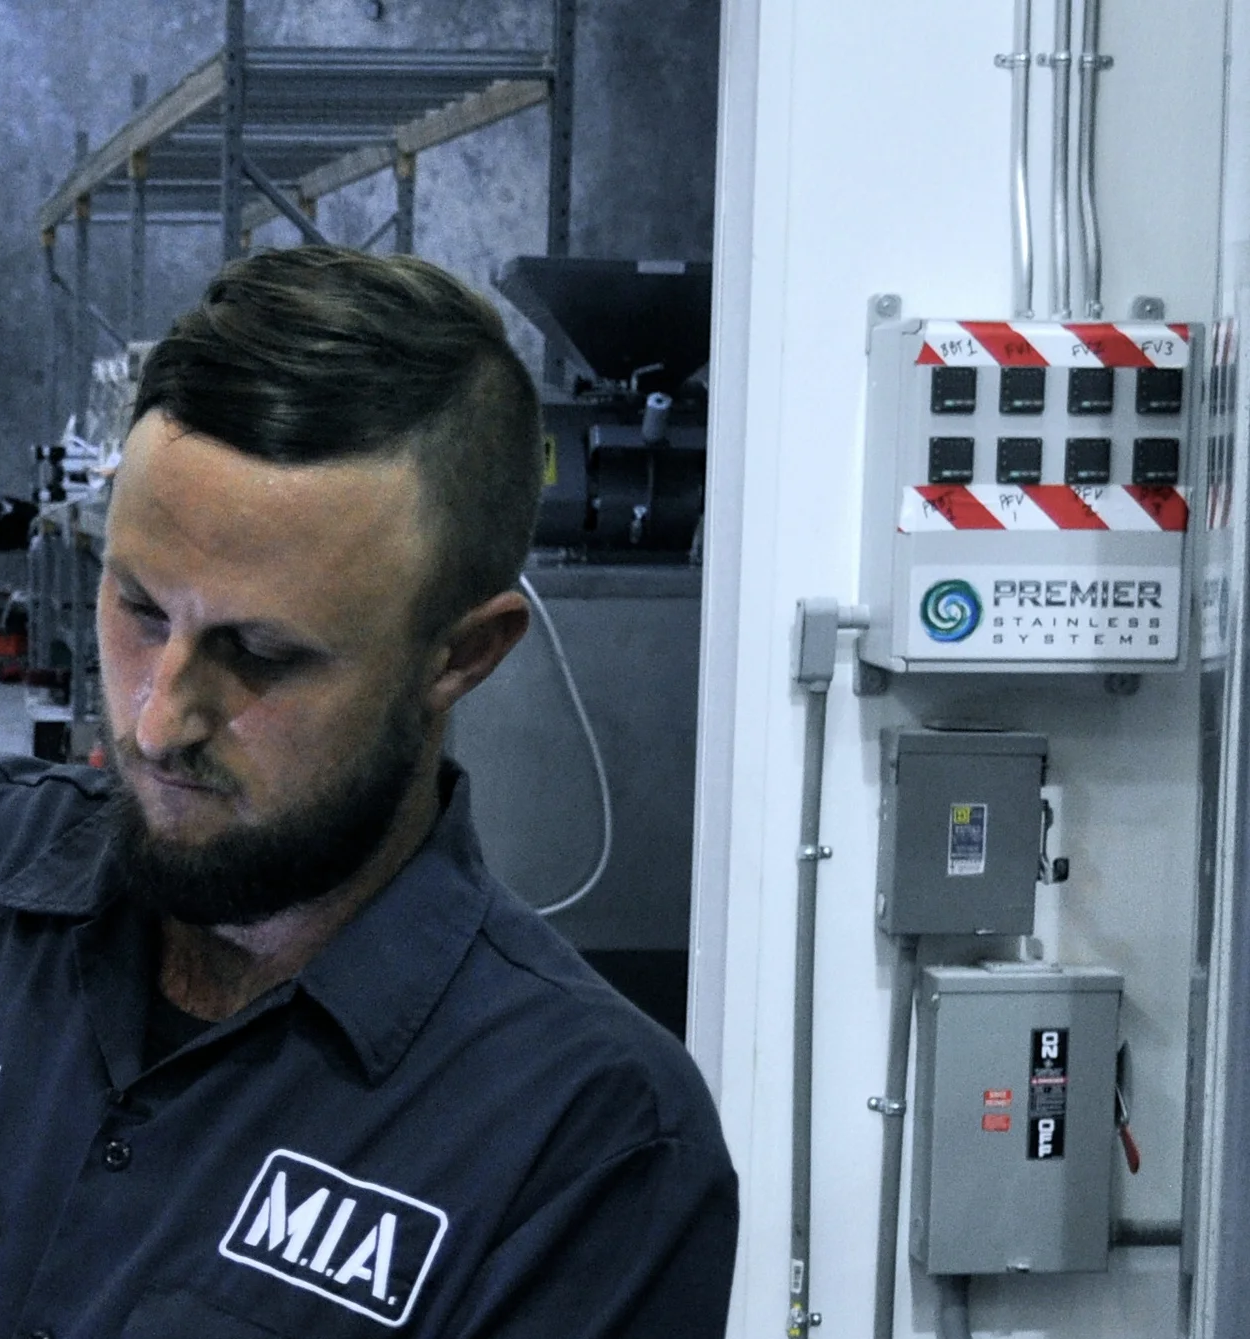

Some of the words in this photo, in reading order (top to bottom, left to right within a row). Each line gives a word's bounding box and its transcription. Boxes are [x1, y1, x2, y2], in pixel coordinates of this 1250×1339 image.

[1141, 339, 1174, 358] FV3
[999, 493, 1024, 511] PFV
[993, 579, 1163, 609] PREMIER
[992, 616, 1160, 628] STAINLESS
[991, 633, 1159, 646] SYSTEMS
[1041, 1031, 1059, 1059] ON
[1037, 1118, 1055, 1158] OFF
